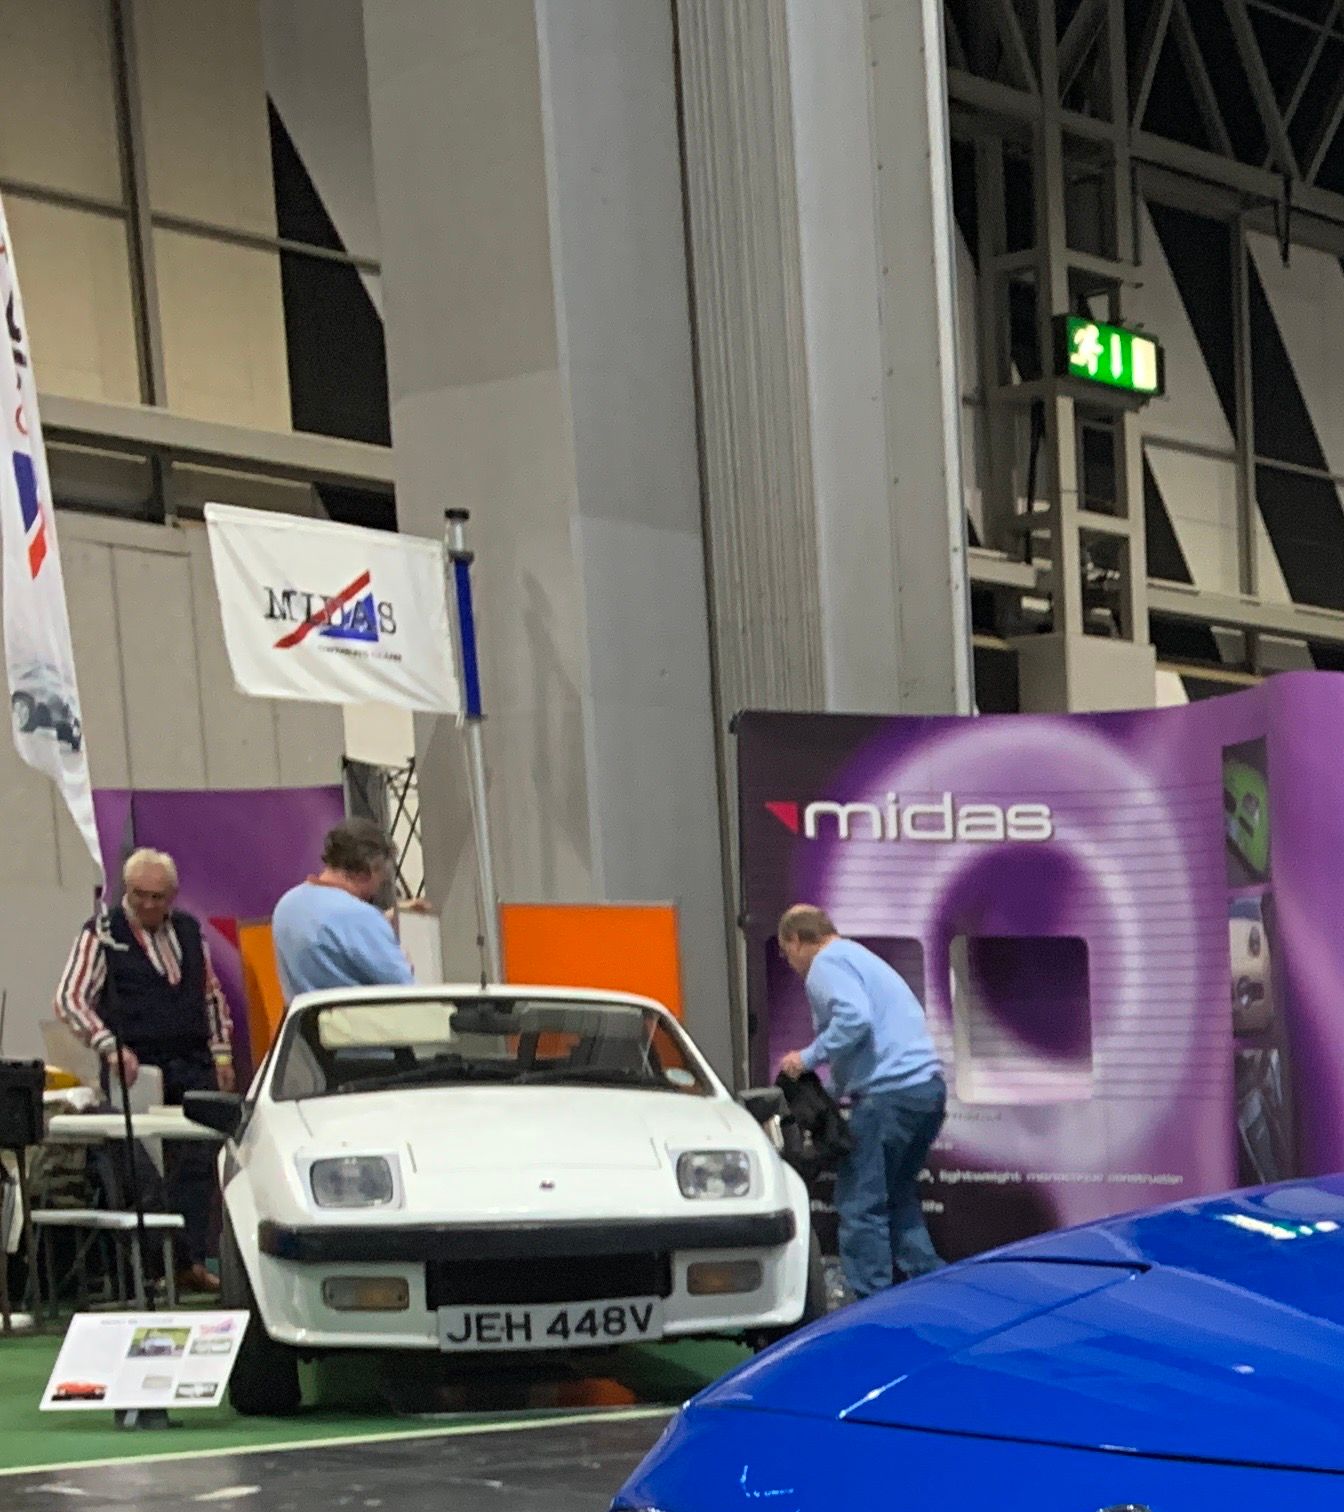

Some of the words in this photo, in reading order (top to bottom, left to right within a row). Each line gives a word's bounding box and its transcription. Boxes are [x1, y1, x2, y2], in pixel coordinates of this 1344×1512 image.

[263, 586, 397, 634] MIDAS
[804, 792, 1052, 840] midas
[447, 1311, 532, 1344] JEH
[546, 1303, 653, 1340] 448V
